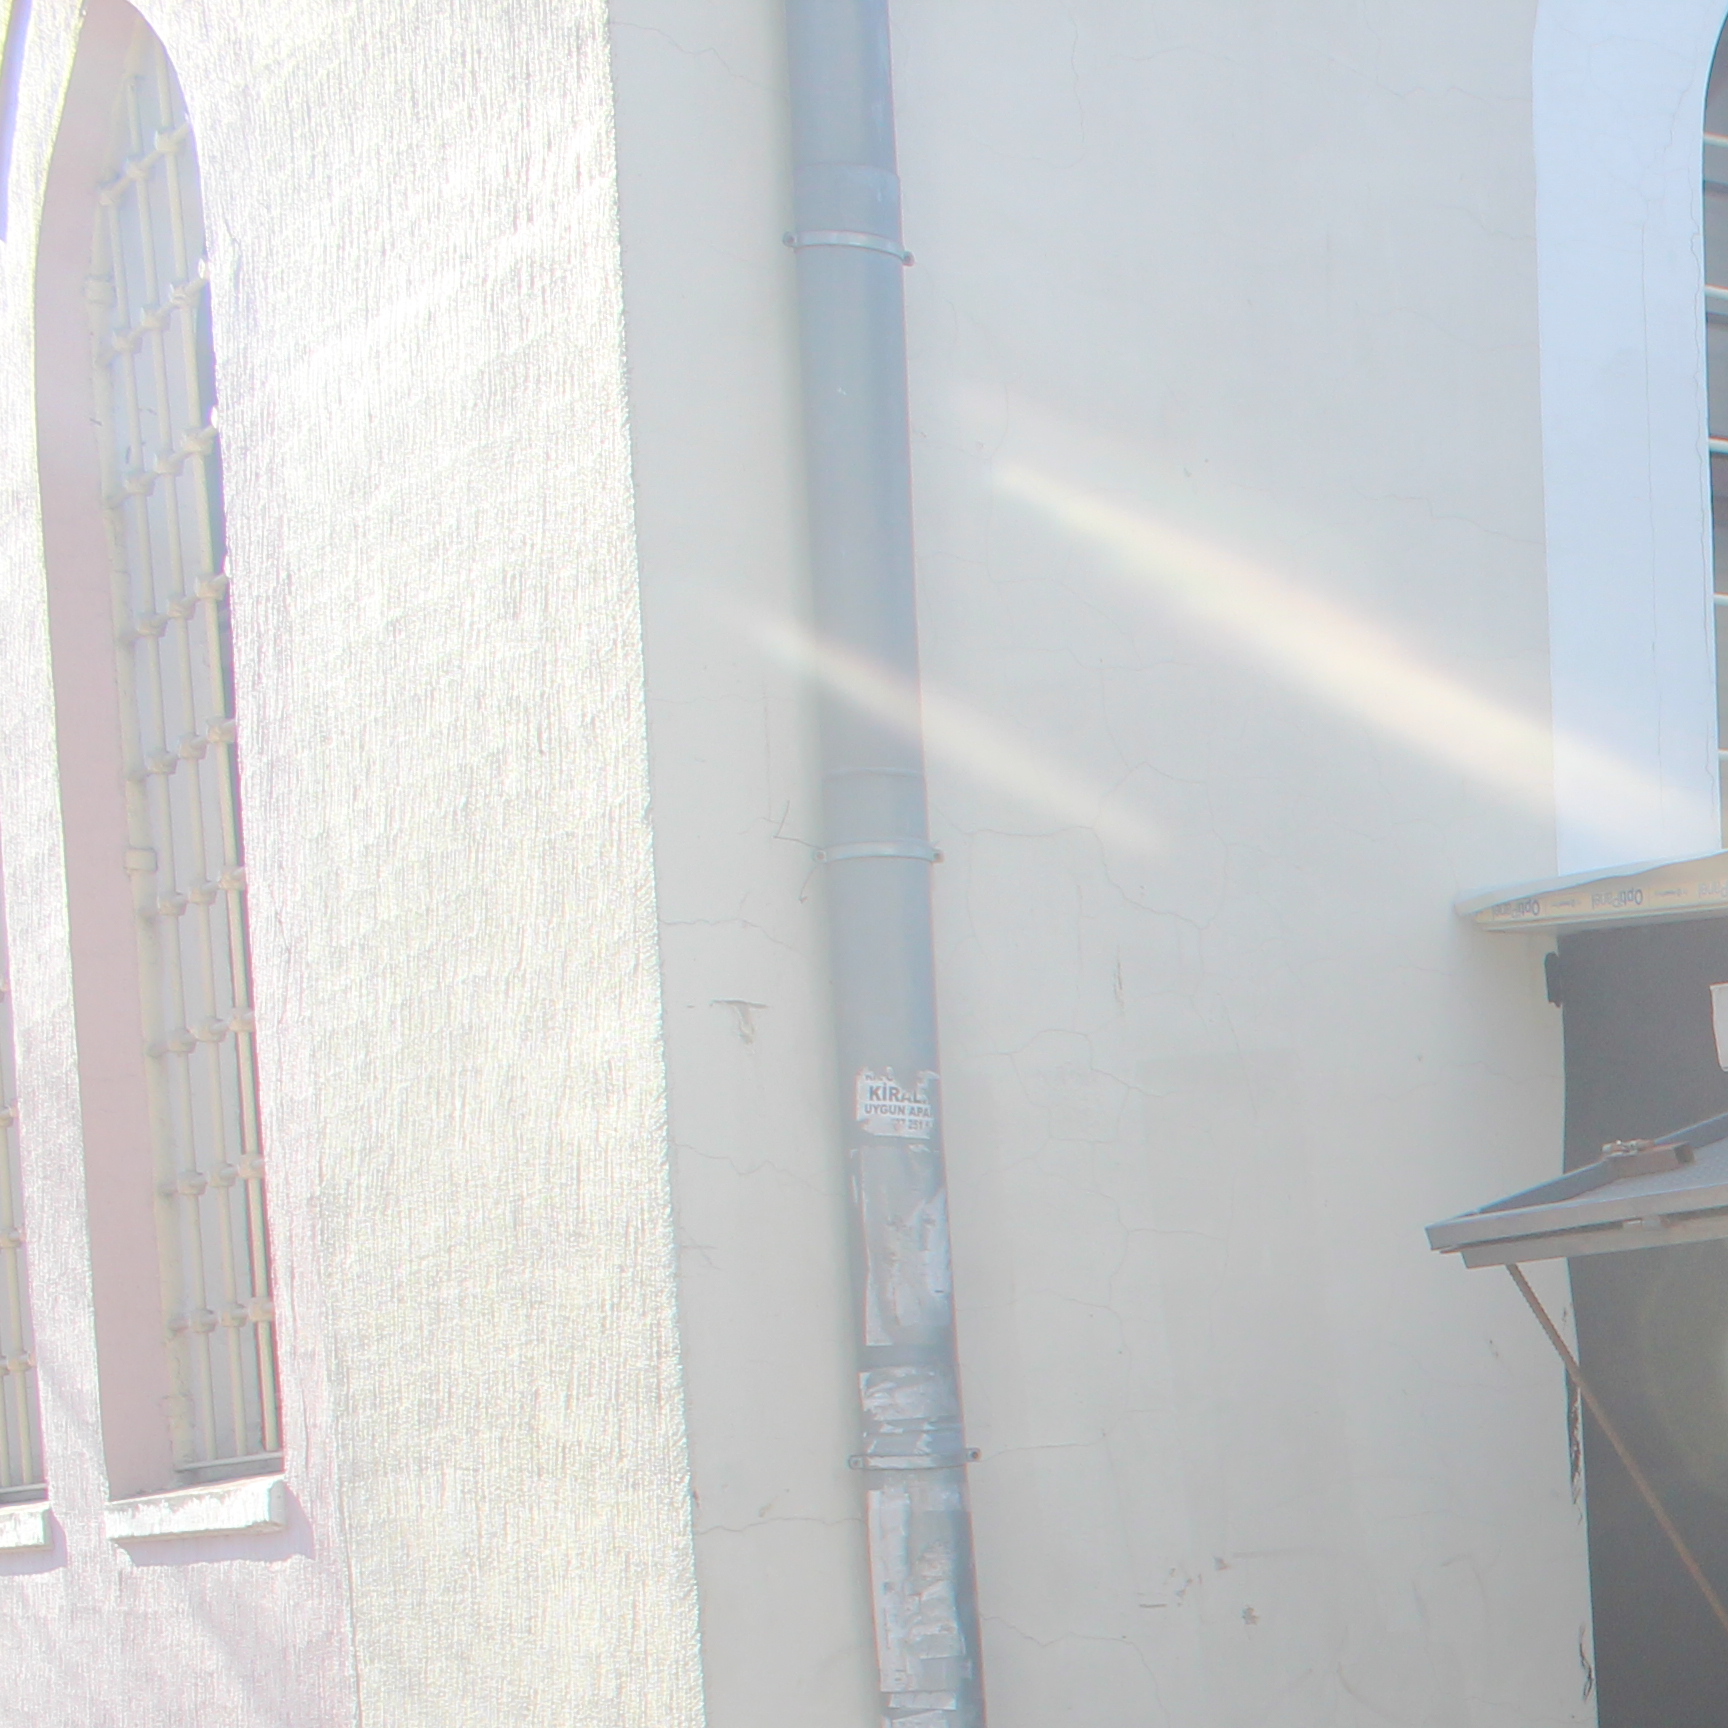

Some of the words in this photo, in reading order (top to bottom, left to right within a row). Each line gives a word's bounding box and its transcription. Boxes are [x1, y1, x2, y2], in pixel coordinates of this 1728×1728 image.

[870, 1082, 927, 1103] KİRAL
[864, 1104, 905, 1115] UYGUN
[909, 1106, 932, 1117] APA
